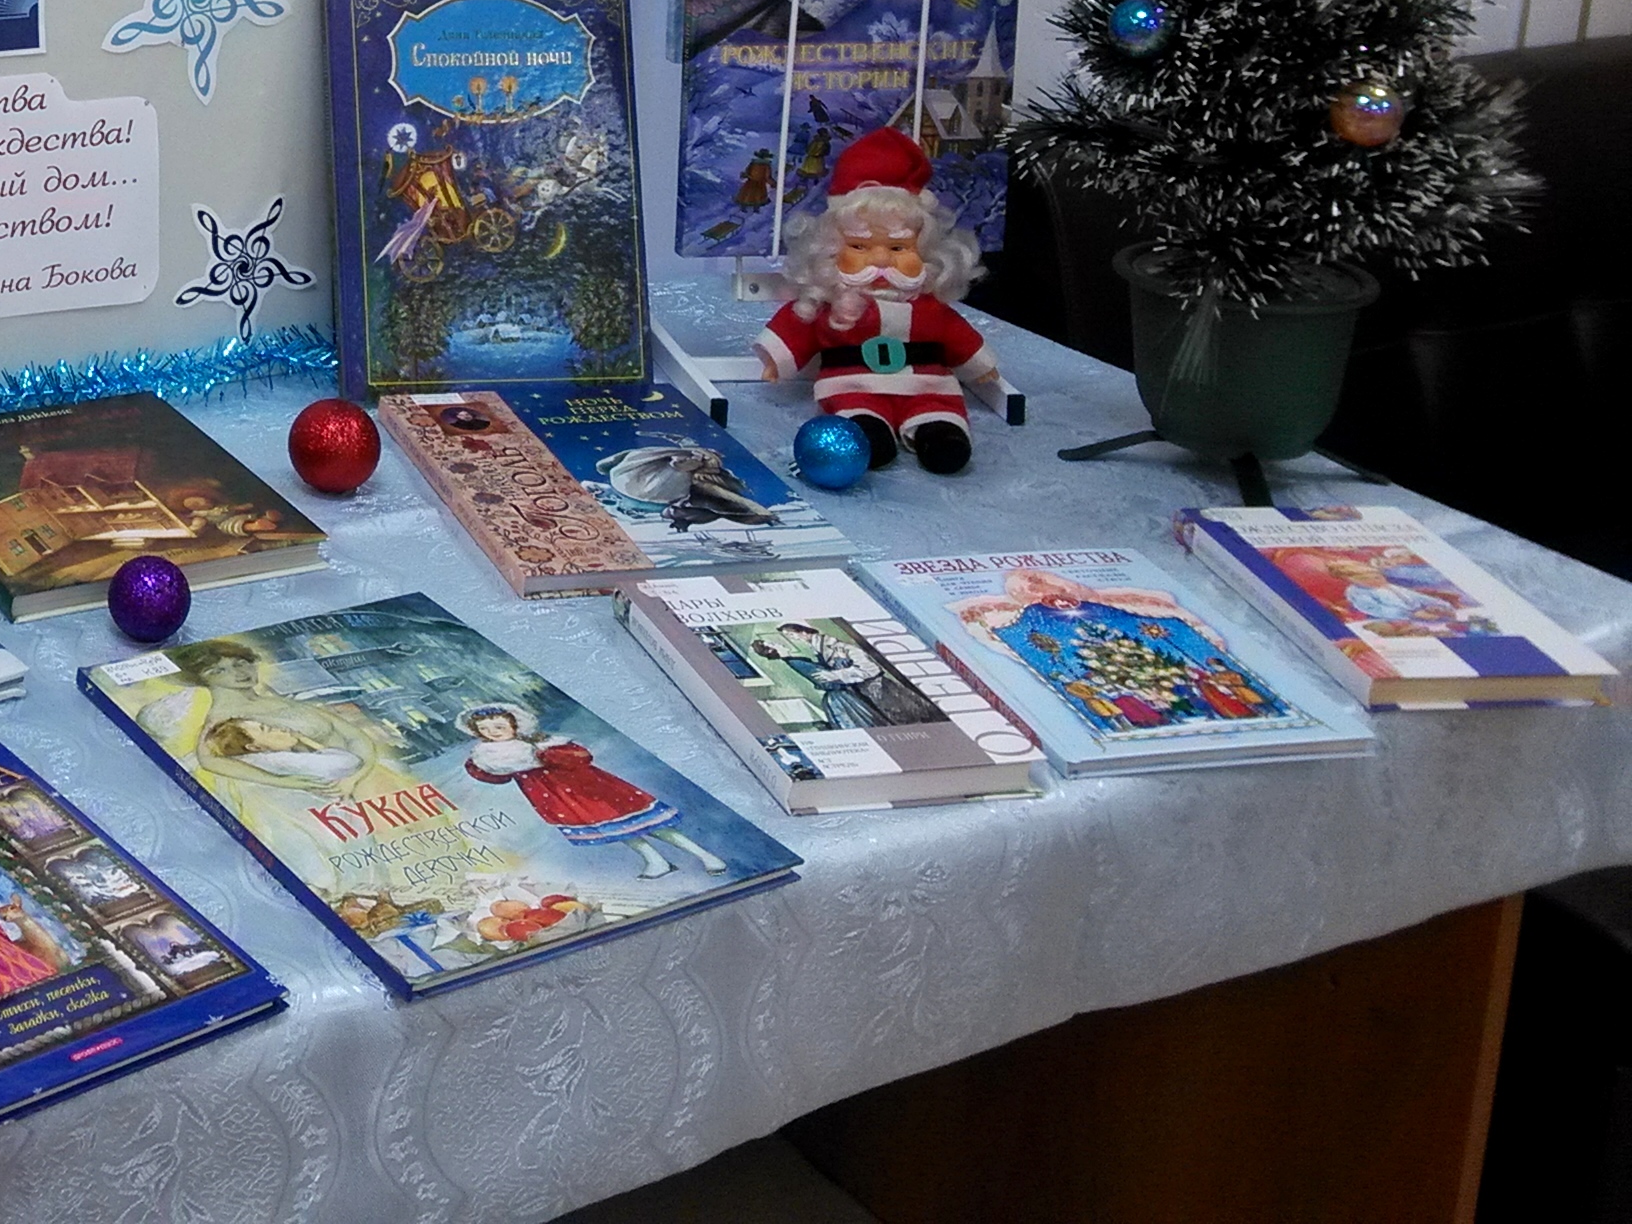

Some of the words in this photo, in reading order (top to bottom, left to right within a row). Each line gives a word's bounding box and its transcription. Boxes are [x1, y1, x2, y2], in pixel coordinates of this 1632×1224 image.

[411, 42, 520, 68] Спокойной
[526, 50, 573, 67] ночи
[42, 163, 139, 194] дом...
[41, 257, 139, 290] Бокова
[537, 410, 685, 426] РОЖДЕСТВОМ
[893, 557, 988, 575] ЗВЕЗДА
[988, 550, 1134, 570] РОЖДЕСТВА
[674, 606, 784, 624] ВОЛХВОВ
[307, 782, 459, 844] КУКЛА
[328, 808, 517, 874] РОЖДЕСТВЕНСКОЙ
[402, 844, 506, 888] ДЕВОЧКИ
